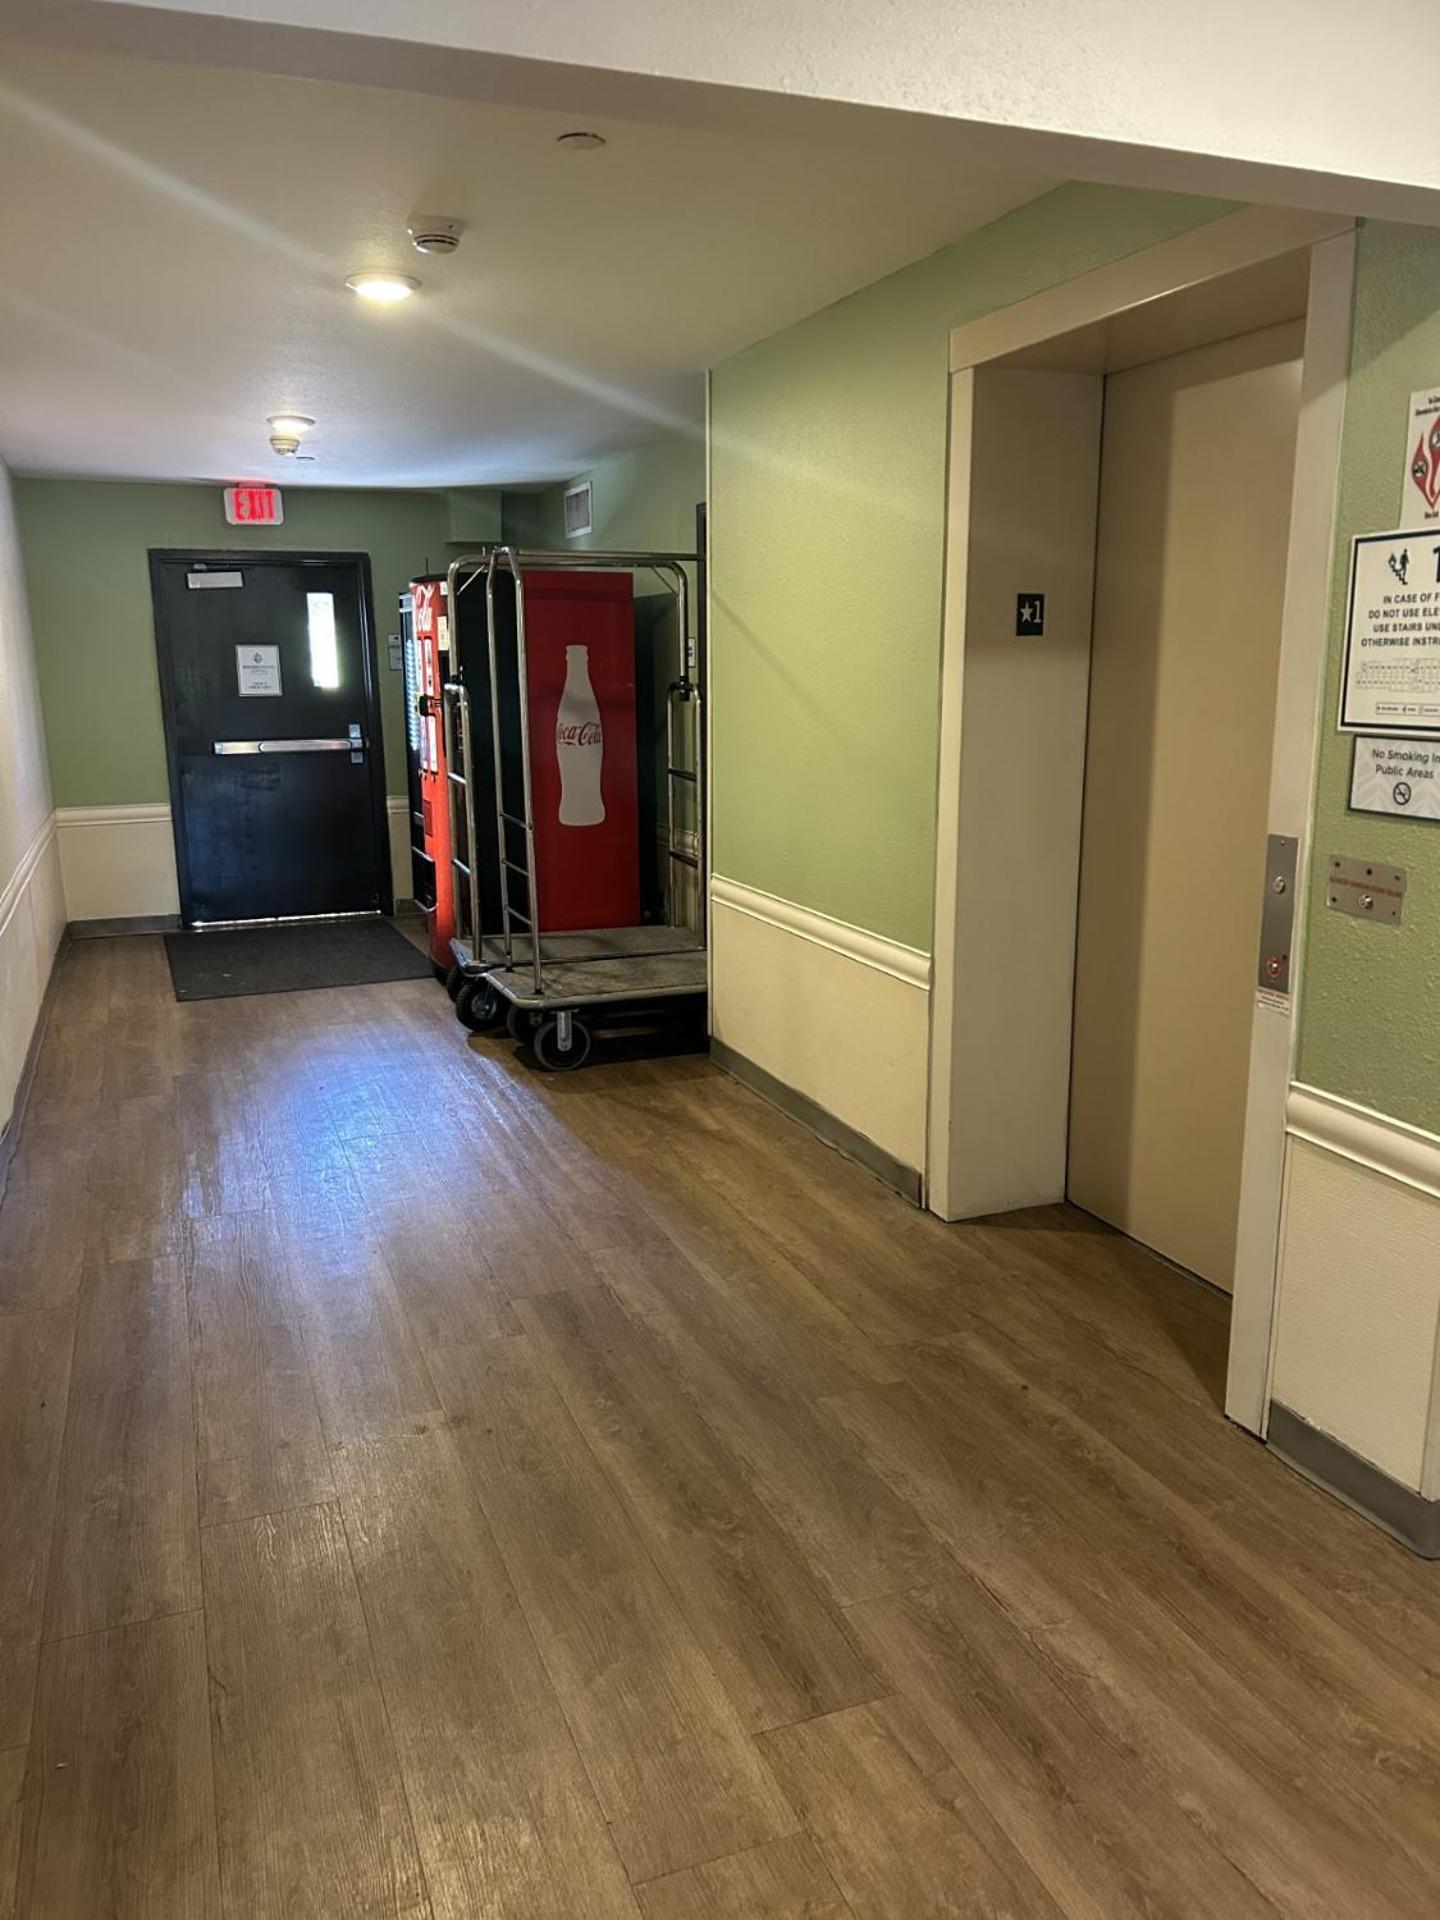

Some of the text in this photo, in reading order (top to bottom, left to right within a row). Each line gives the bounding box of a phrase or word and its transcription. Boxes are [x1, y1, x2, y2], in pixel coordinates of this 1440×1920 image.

[234, 489, 274, 521] EXIT
[1383, 596, 1392, 604] IN
[1394, 594, 1418, 604] CASE
[1420, 592, 1432, 603] OF
[1368, 607, 1440, 619] DO NOT USE ELE
[1373, 624, 1389, 633] USE
[1392, 622, 1422, 632] STAIRS
[1361, 636, 1440, 647] OTHERWISE INSTR
[1372, 749, 1385, 759] No
[1387, 749, 1429, 765] Smoking
[1375, 763, 1434, 779] Public Areas
